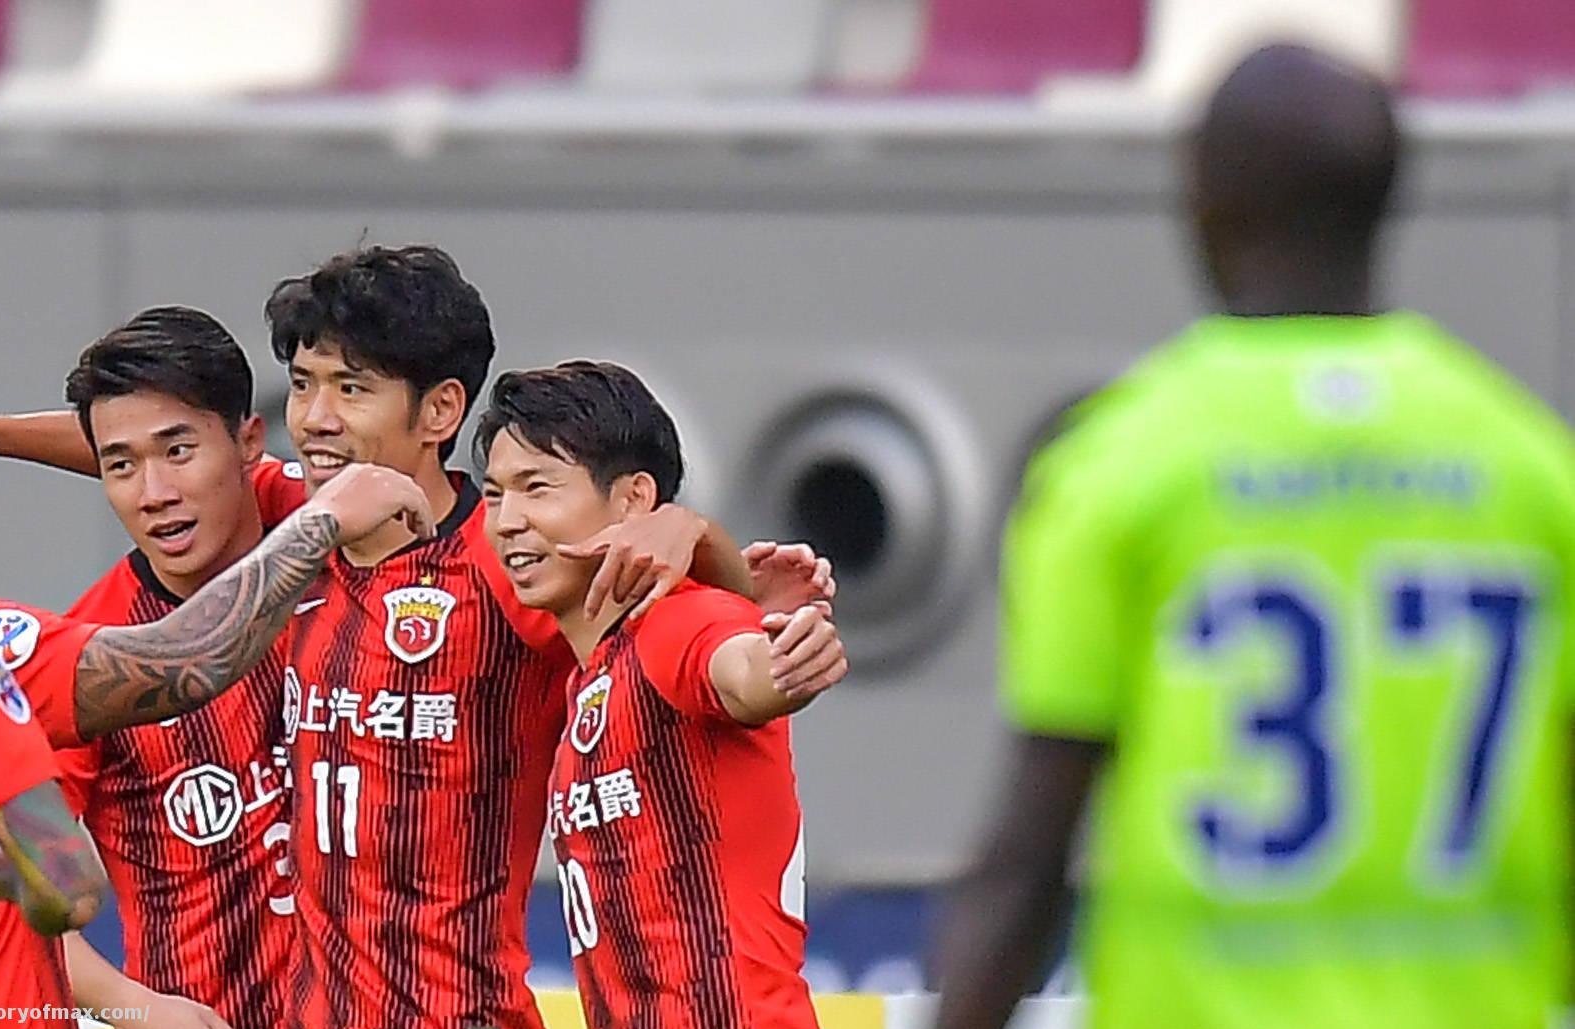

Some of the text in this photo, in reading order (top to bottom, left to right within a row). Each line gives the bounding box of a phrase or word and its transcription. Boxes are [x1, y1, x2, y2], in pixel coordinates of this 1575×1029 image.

[299, 683, 458, 742] 上汽名爵
[1173, 568, 1545, 878] 37
[168, 768, 239, 843] MG
[312, 761, 360, 858] 11
